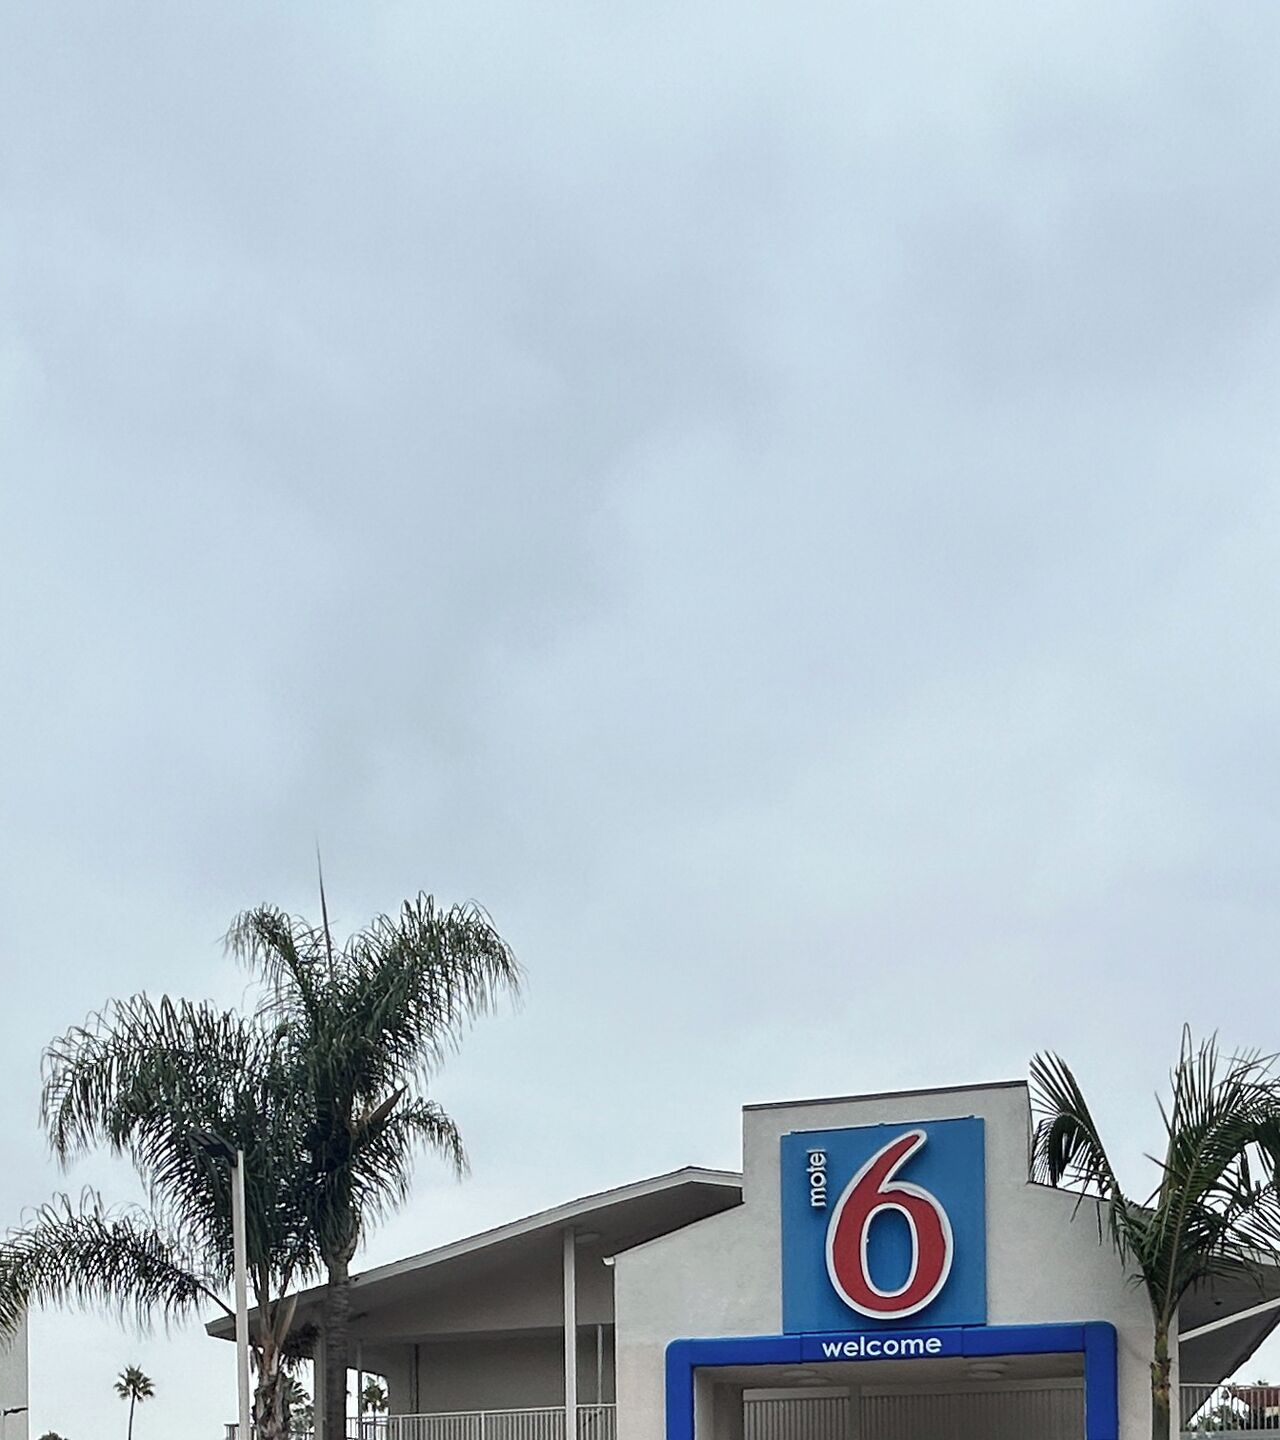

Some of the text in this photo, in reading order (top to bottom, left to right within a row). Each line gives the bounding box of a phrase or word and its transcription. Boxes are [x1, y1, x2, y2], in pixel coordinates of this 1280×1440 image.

[806, 1129, 955, 1320] motel 6
[821, 1336, 942, 1358] welcome
